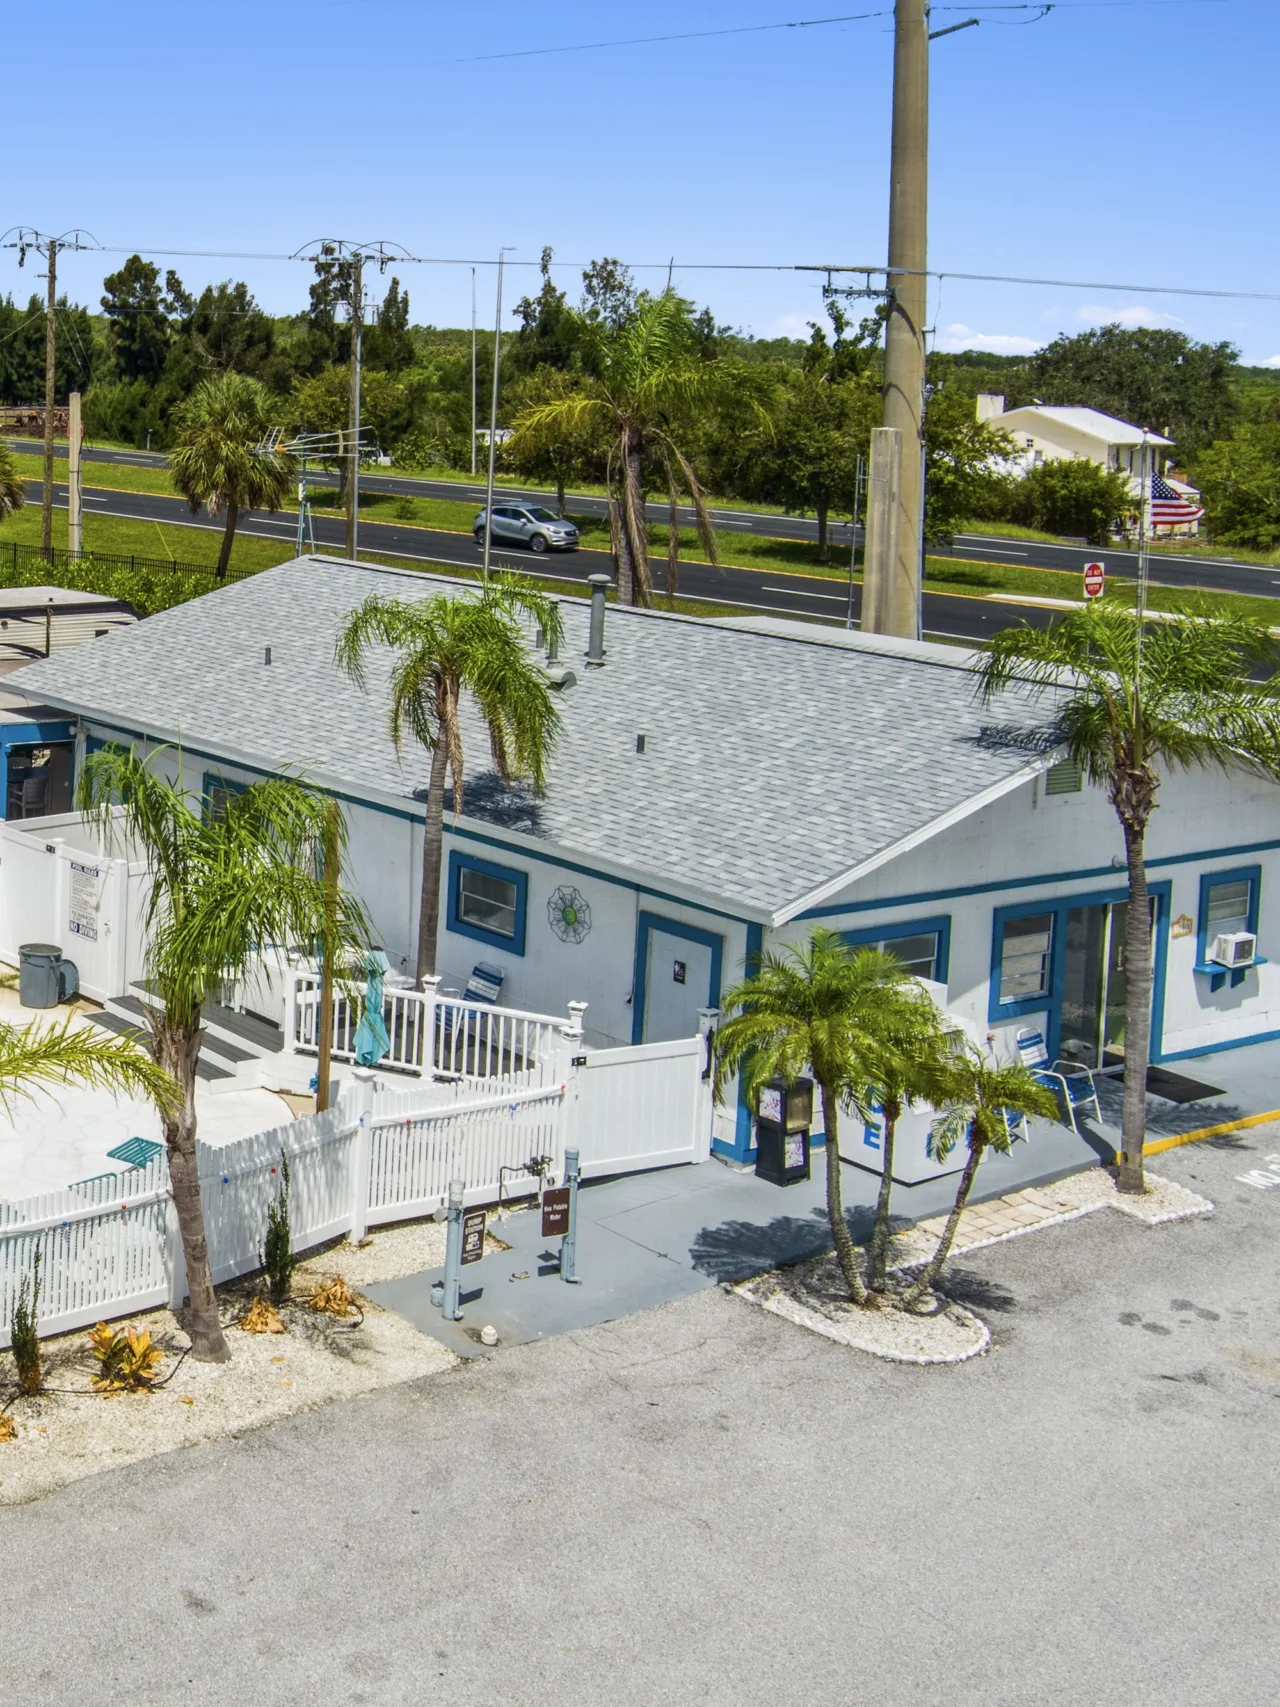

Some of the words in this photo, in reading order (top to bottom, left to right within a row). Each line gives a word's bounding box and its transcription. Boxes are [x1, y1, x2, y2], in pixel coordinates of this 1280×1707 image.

[72, 863, 82, 872] POOL
[70, 921, 78, 932] NO
[79, 924, 97, 940] DIVING
[553, 1203, 568, 1211] Potable
[468, 1216, 482, 1227] DUMP
[465, 1223, 483, 1235] STATION
